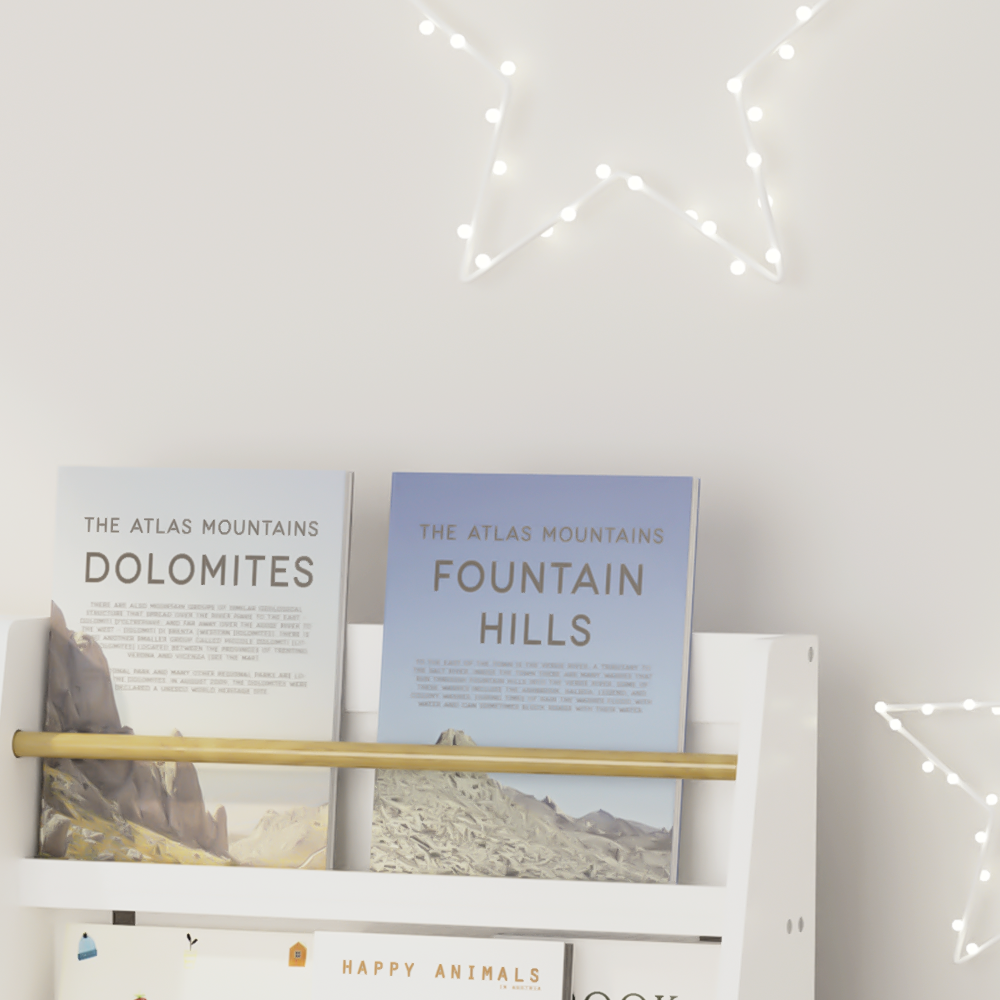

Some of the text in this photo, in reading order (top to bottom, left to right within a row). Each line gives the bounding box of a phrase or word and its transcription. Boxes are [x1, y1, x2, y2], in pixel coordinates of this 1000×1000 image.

[84, 516, 319, 537] THE ATLAS MOUNTAINS
[419, 523, 664, 544] THE ATLAS MOUNTAINS
[84, 551, 314, 588] DOLOMITES
[433, 559, 644, 596] FOUNTAIN
[480, 612, 592, 647] HILLS
[342, 959, 540, 983] HAPPY ANIMALS
